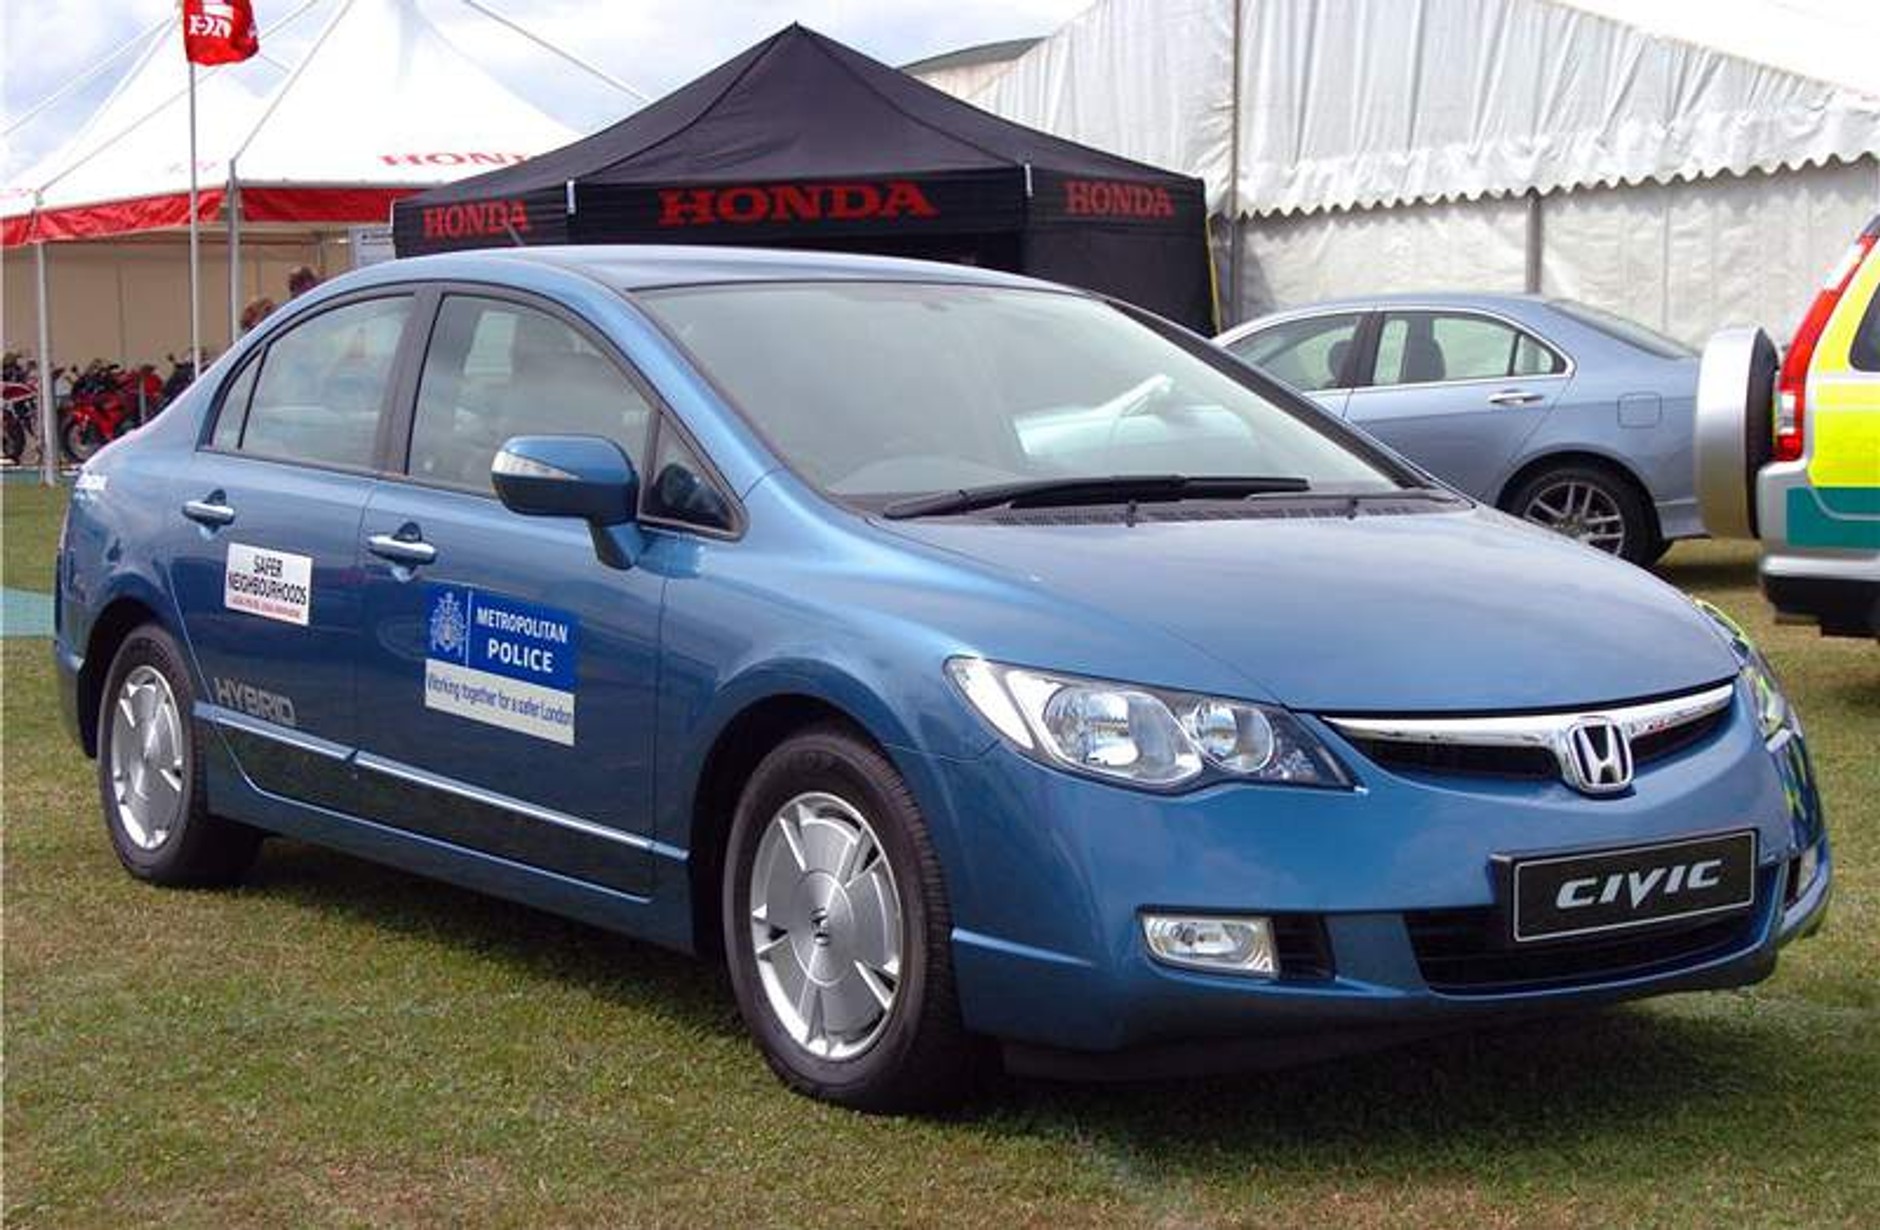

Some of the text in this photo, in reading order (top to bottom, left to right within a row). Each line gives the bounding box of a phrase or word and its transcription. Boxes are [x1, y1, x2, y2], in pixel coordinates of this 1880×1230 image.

[377, 152, 529, 167] HON
[658, 180, 940, 227] HONDA
[1064, 181, 1176, 219] HONDA
[423, 201, 529, 239] HONDA
[254, 555, 283, 578] SAFER
[228, 571, 306, 605] NEIGHBOURHOODS
[476, 607, 569, 643] METROPOLITAN
[488, 638, 554, 673] POLICE
[214, 677, 296, 725] HYBRID
[1556, 859, 1723, 909] CIVIC
